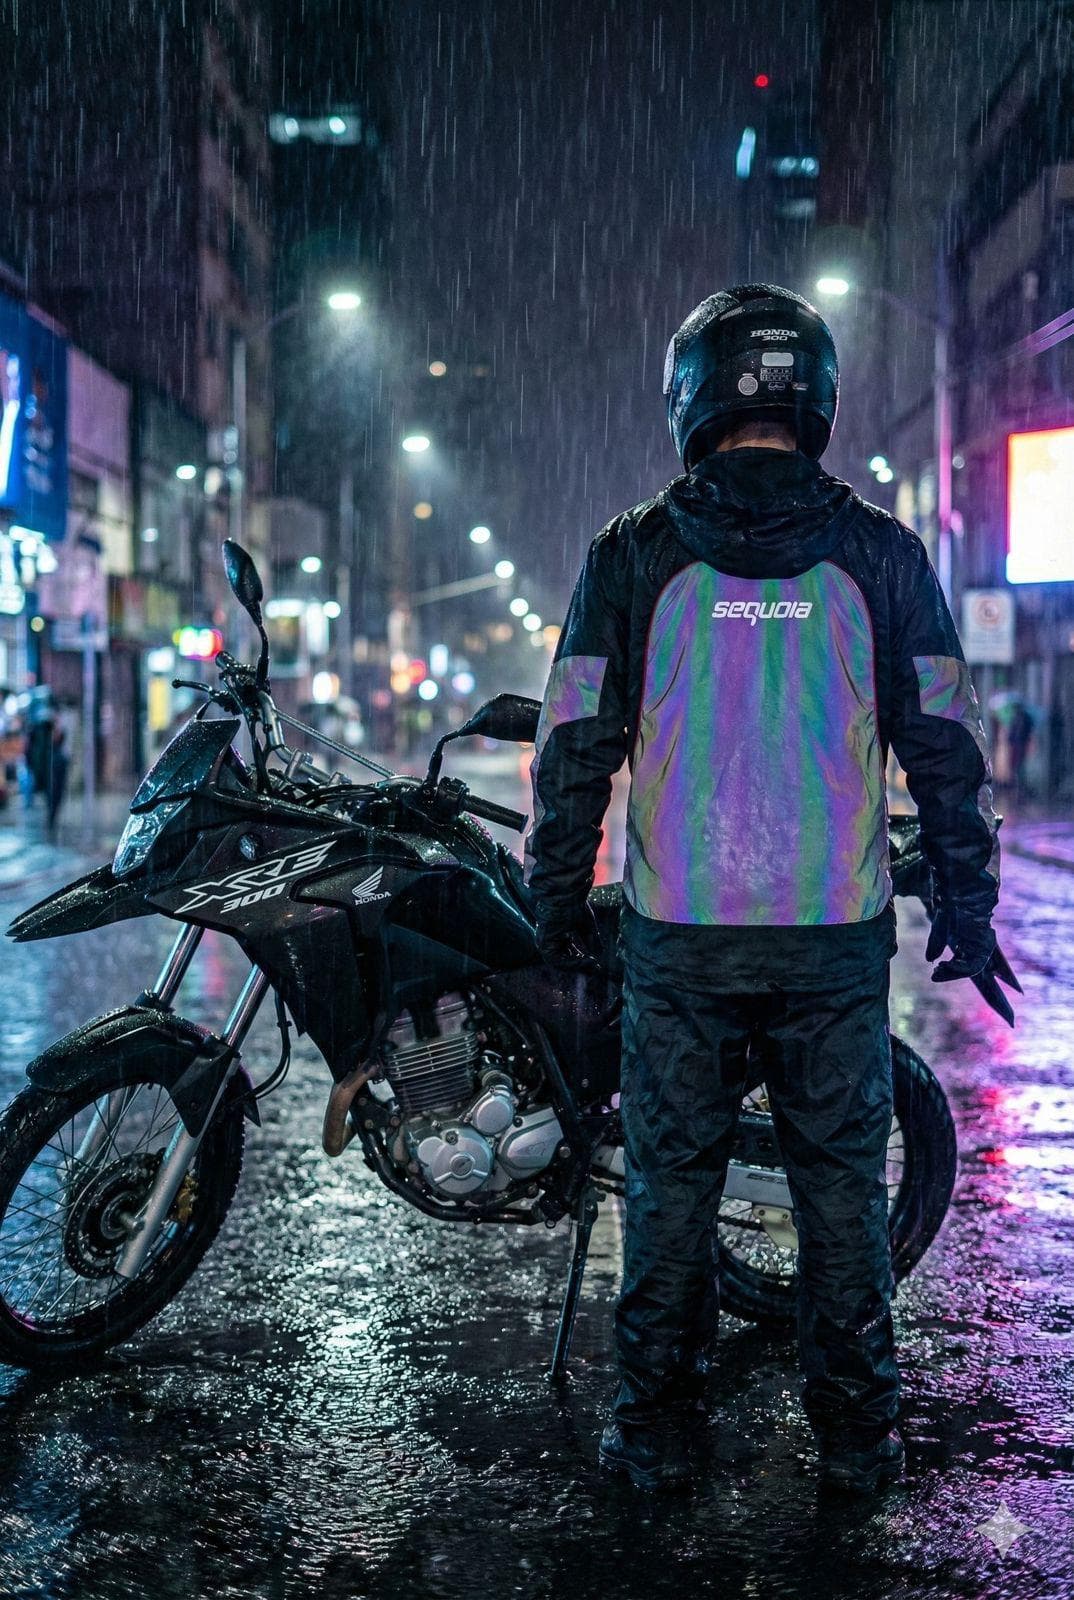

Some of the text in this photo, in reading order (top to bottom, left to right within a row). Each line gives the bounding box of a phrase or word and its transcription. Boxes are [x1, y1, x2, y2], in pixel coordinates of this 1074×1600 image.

[750, 329, 799, 338] HONDA
[174, 840, 338, 914] XRE
[220, 883, 286, 914] 300
[355, 891, 392, 906] HONDA
